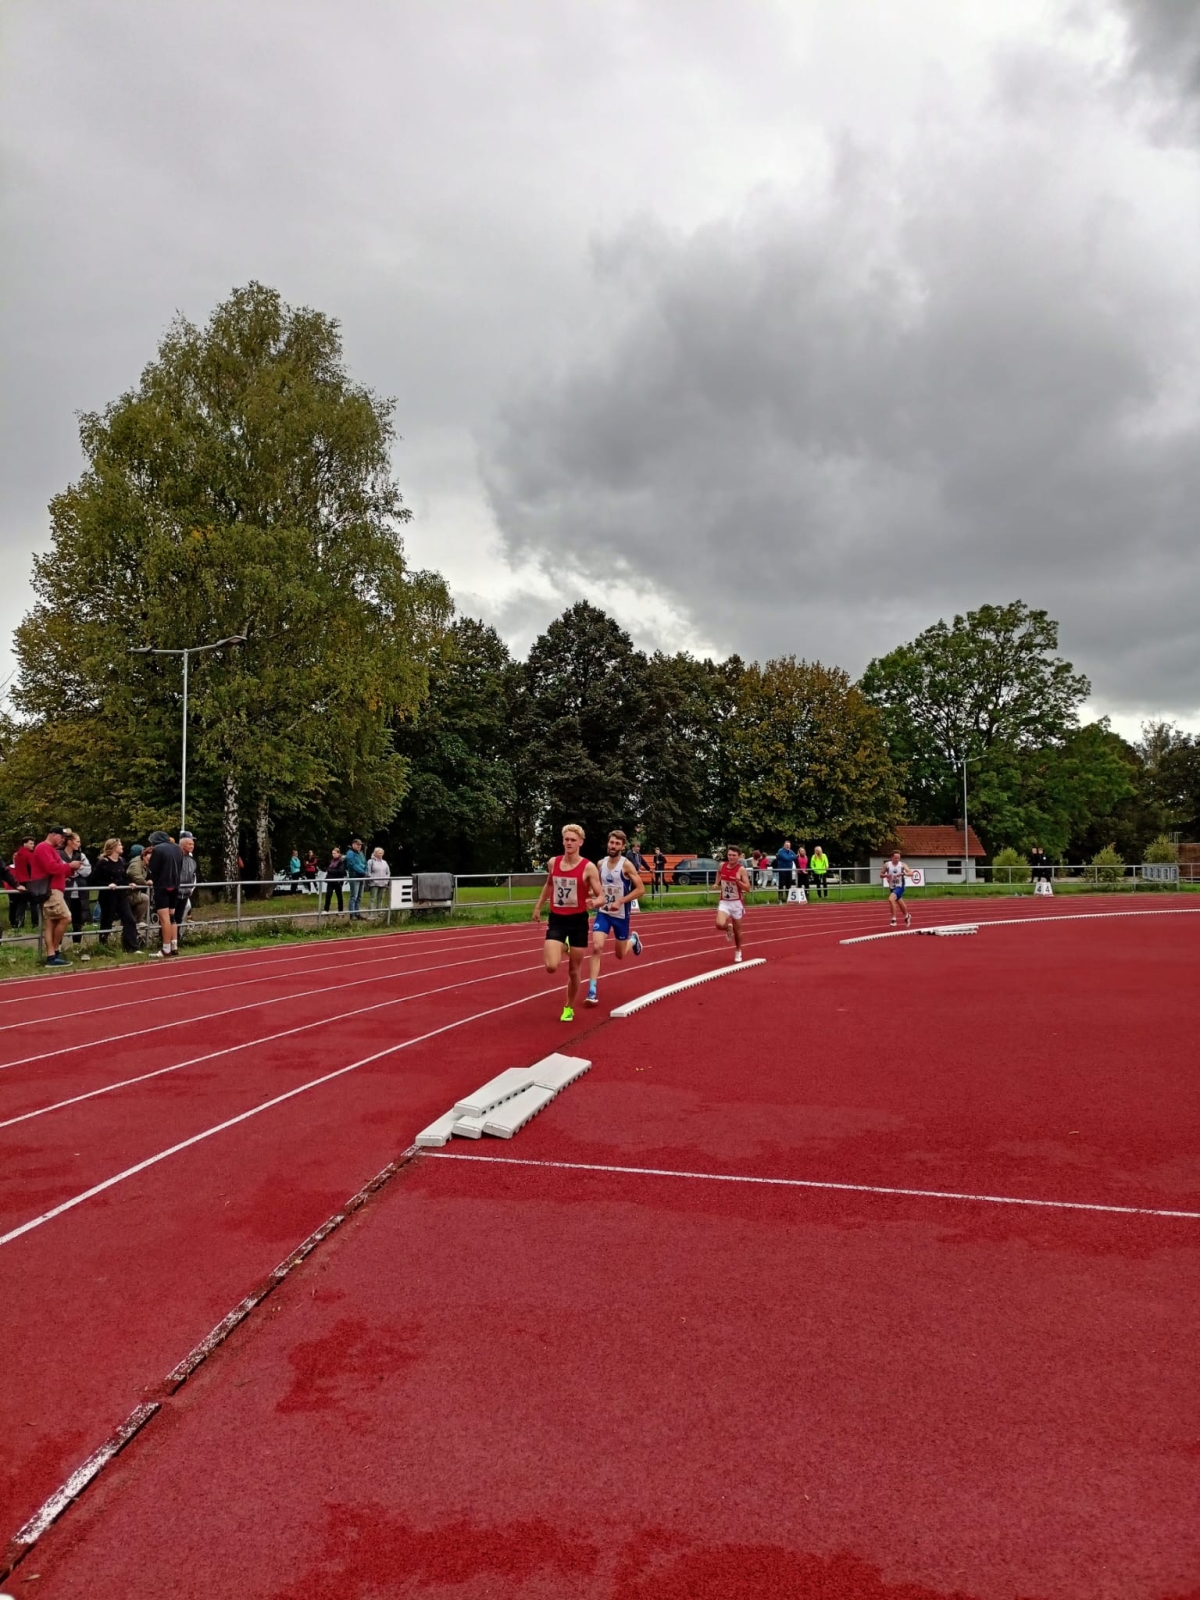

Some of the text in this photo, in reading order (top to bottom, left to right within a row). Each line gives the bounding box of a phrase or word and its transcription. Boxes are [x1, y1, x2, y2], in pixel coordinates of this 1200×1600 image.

[557, 887, 571, 898] 37
[790, 891, 796, 900] 5
[800, 891, 805, 900] 5
[605, 895, 615, 904] 34
